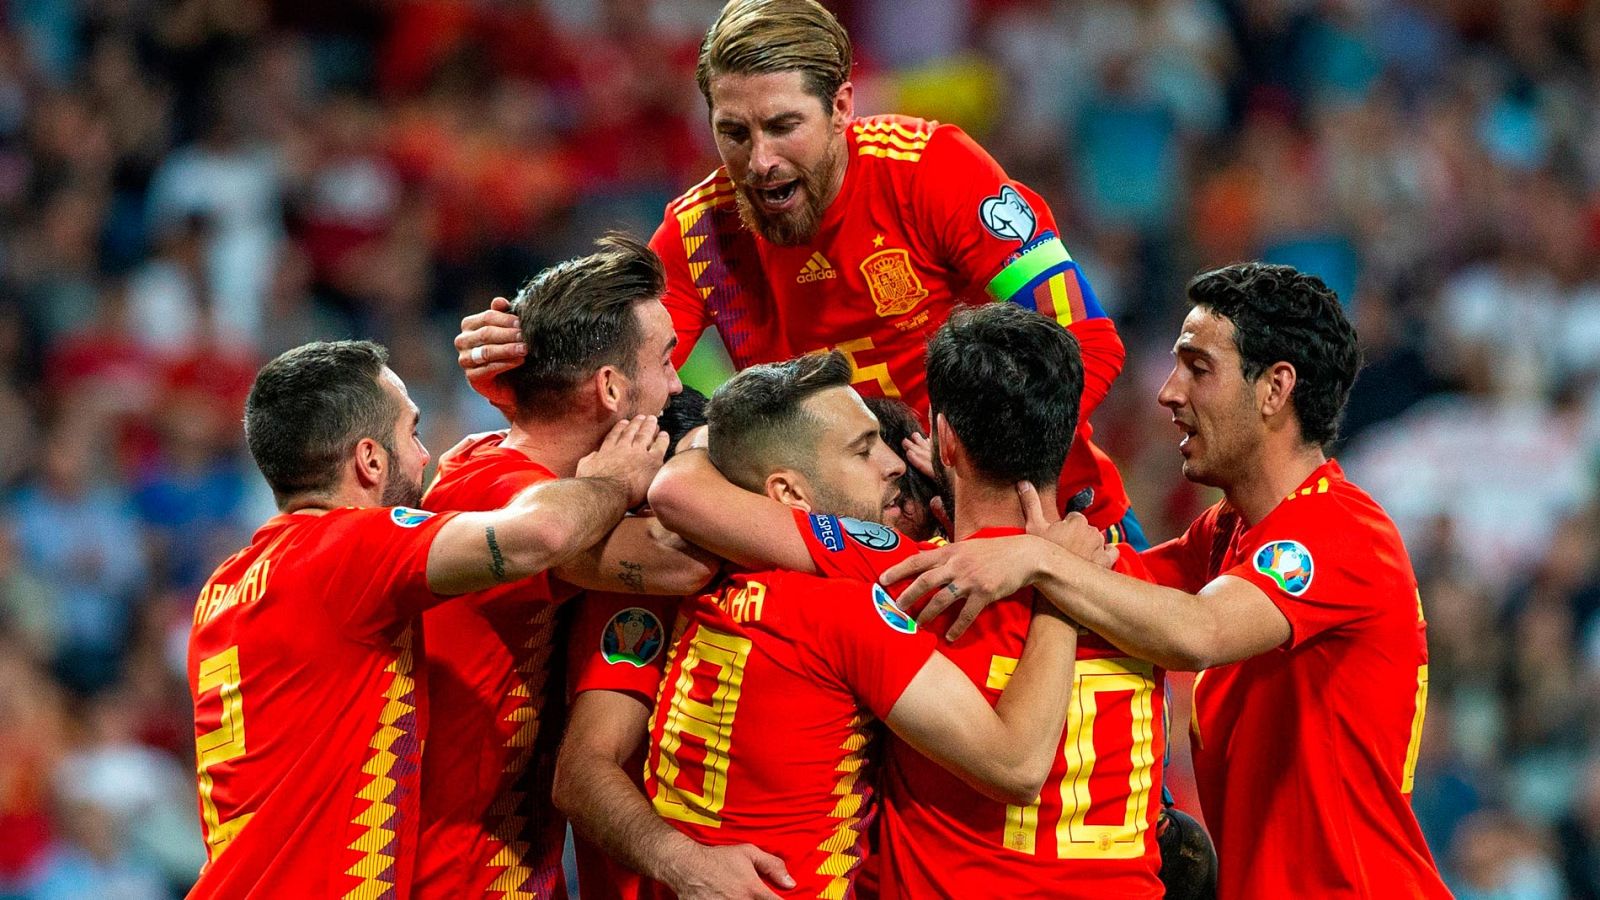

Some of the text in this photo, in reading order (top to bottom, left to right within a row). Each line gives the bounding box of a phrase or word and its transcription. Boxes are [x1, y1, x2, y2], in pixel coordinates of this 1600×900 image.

[796, 268, 837, 284] adidas
[805, 336, 902, 397] 5
[195, 644, 256, 864] 2
